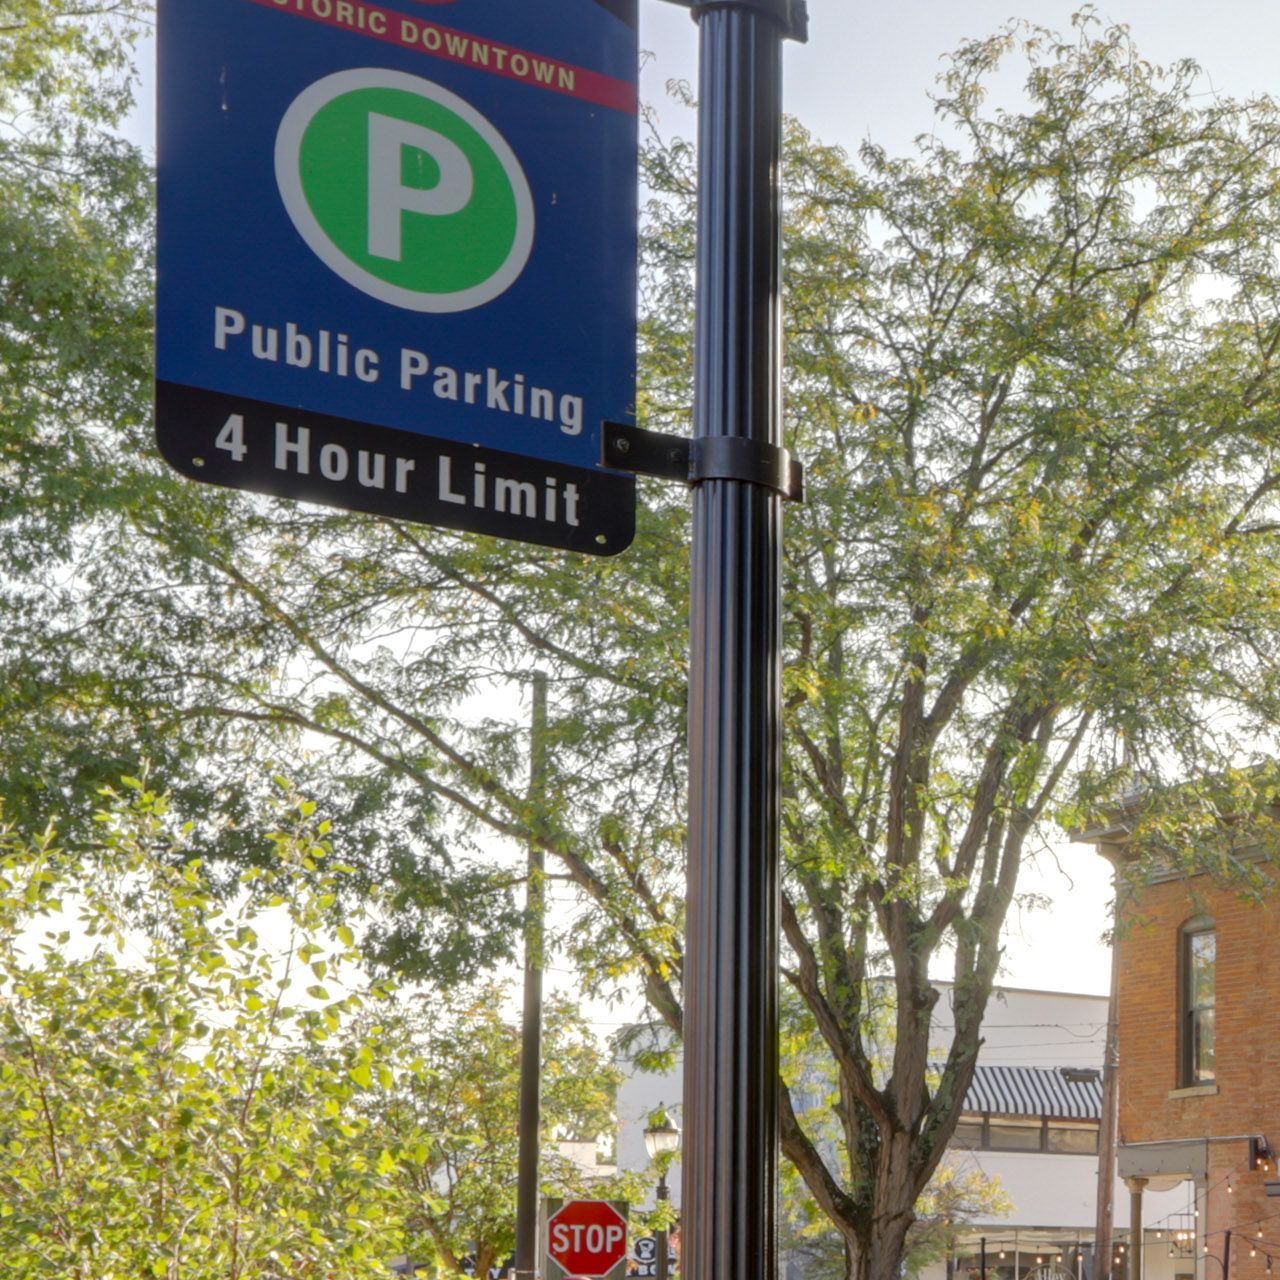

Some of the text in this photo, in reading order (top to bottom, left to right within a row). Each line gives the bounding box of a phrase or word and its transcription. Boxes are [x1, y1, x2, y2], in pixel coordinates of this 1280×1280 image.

[274, 0, 576, 91] ORIC DOWNTOWN
[367, 111, 474, 262] P
[213, 306, 584, 436] Public Parking
[215, 414, 580, 527] 4 Hour Limit
[552, 1223, 623, 1253] STOP
